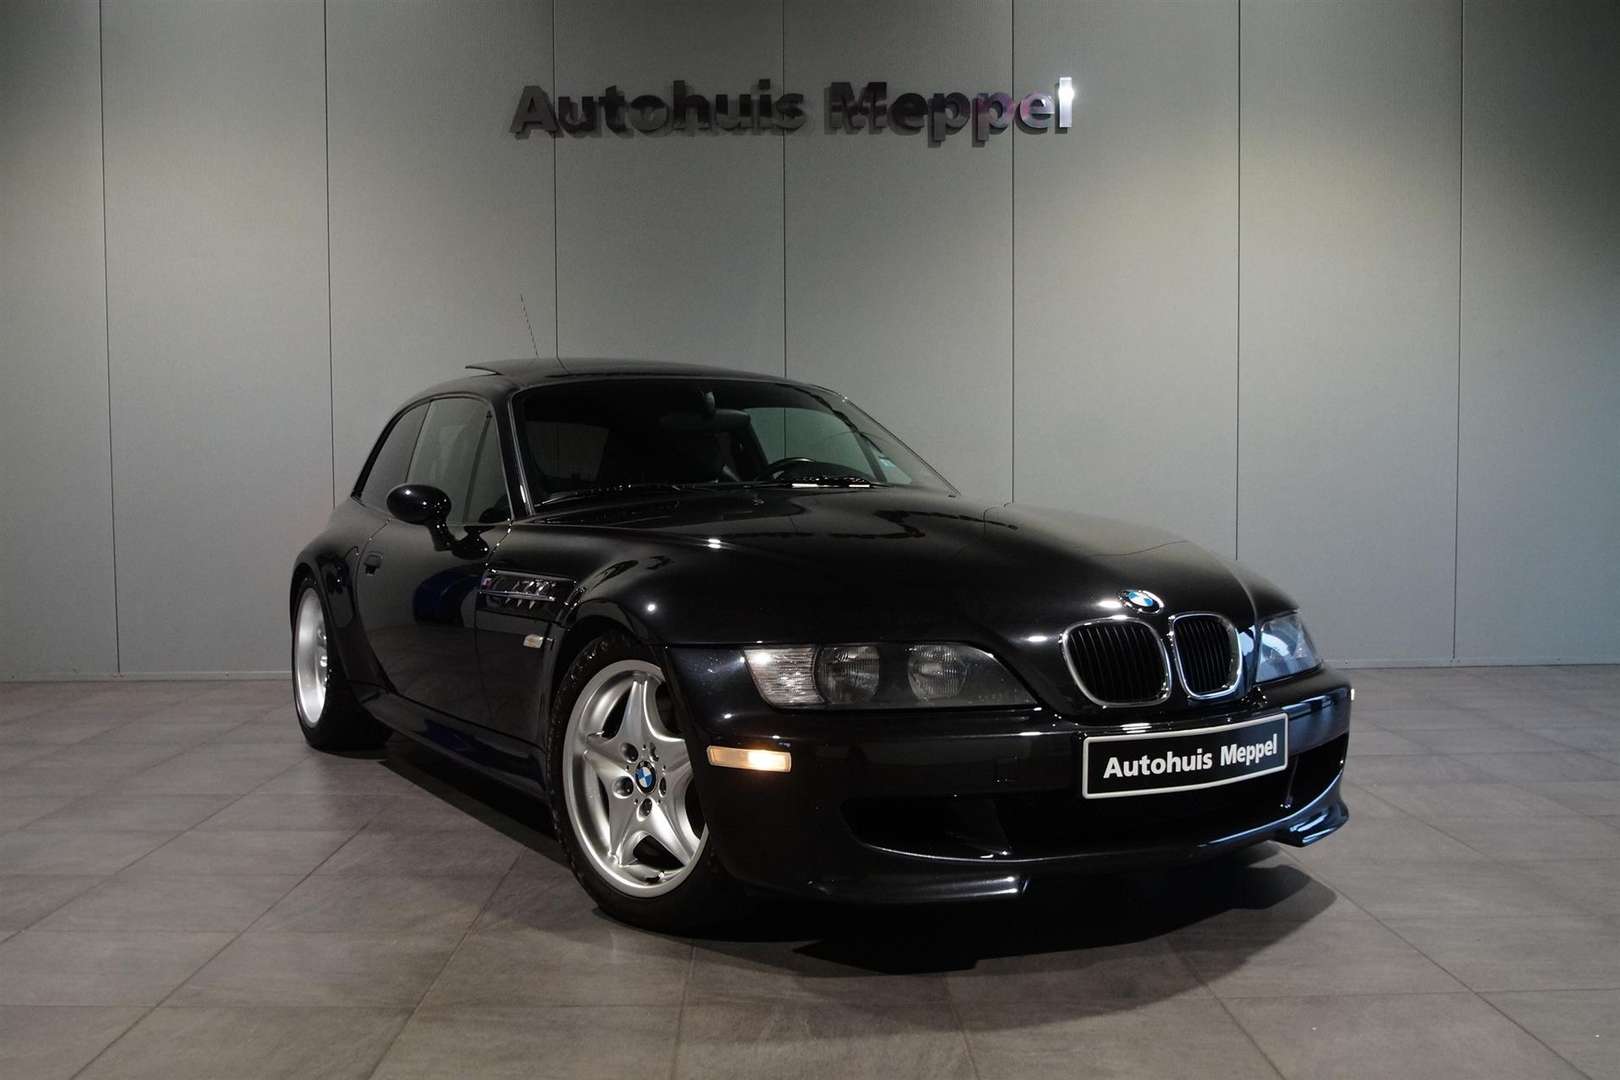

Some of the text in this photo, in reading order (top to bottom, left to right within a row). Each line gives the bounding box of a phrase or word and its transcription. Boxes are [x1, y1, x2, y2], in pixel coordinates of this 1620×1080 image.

[511, 77, 1073, 147] Autohuis Meppel
[1103, 733, 1278, 779] Autohuis Meppel
